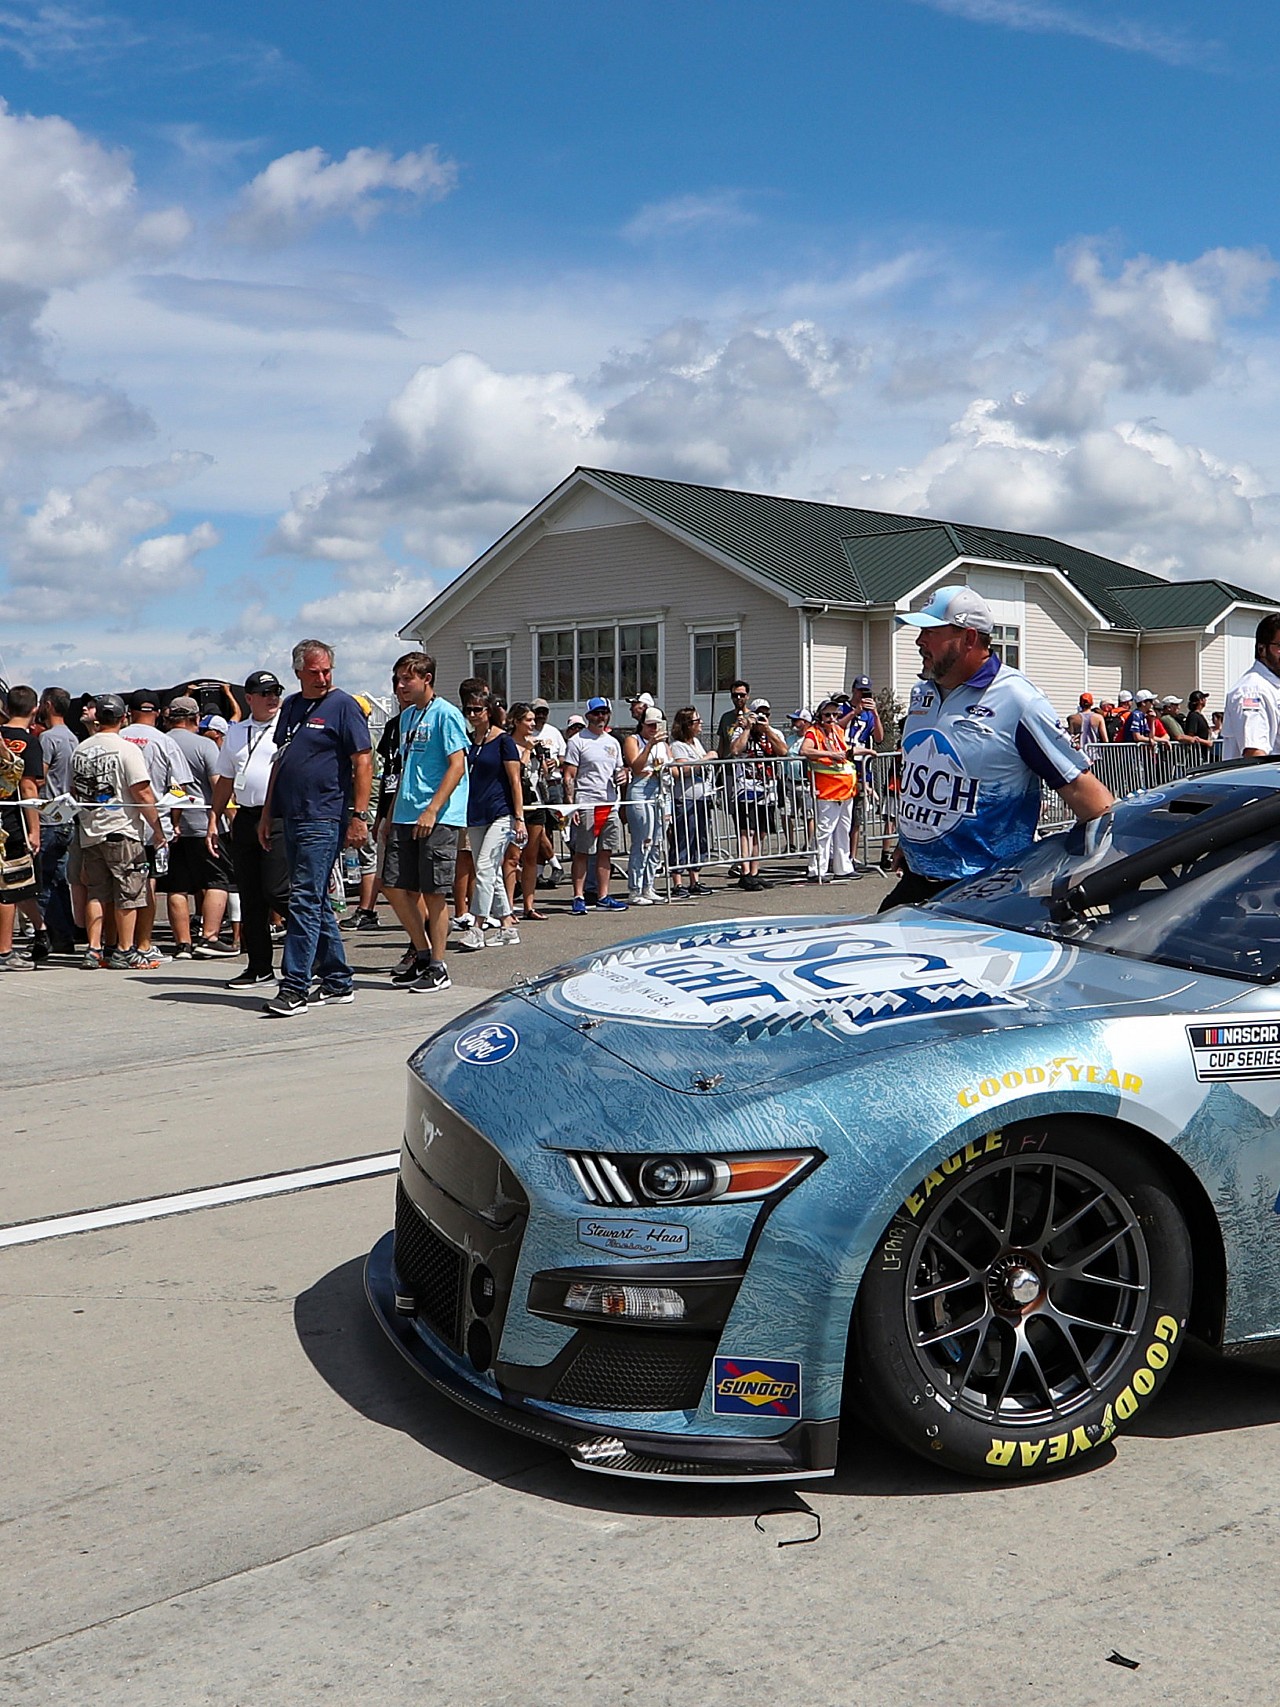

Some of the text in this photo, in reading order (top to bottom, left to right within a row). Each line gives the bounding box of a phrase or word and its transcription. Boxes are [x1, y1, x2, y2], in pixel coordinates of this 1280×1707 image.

[954, 612, 969, 624] 4
[900, 761, 979, 814] USCH
[900, 803, 946, 827] IGHT
[460, 1026, 508, 1059] Ford
[1223, 1026, 1279, 1044] NASCAR
[1209, 1053, 1235, 1067] CUP
[957, 1059, 1143, 1108] GOODYEAR
[904, 1129, 1003, 1218] EAGLE
[581, 1222, 639, 1240] Stewart
[646, 1228, 683, 1243] Haas
[720, 1380, 795, 1398] SUNOCO
[985, 1315, 1178, 1467] GOODYEAR
